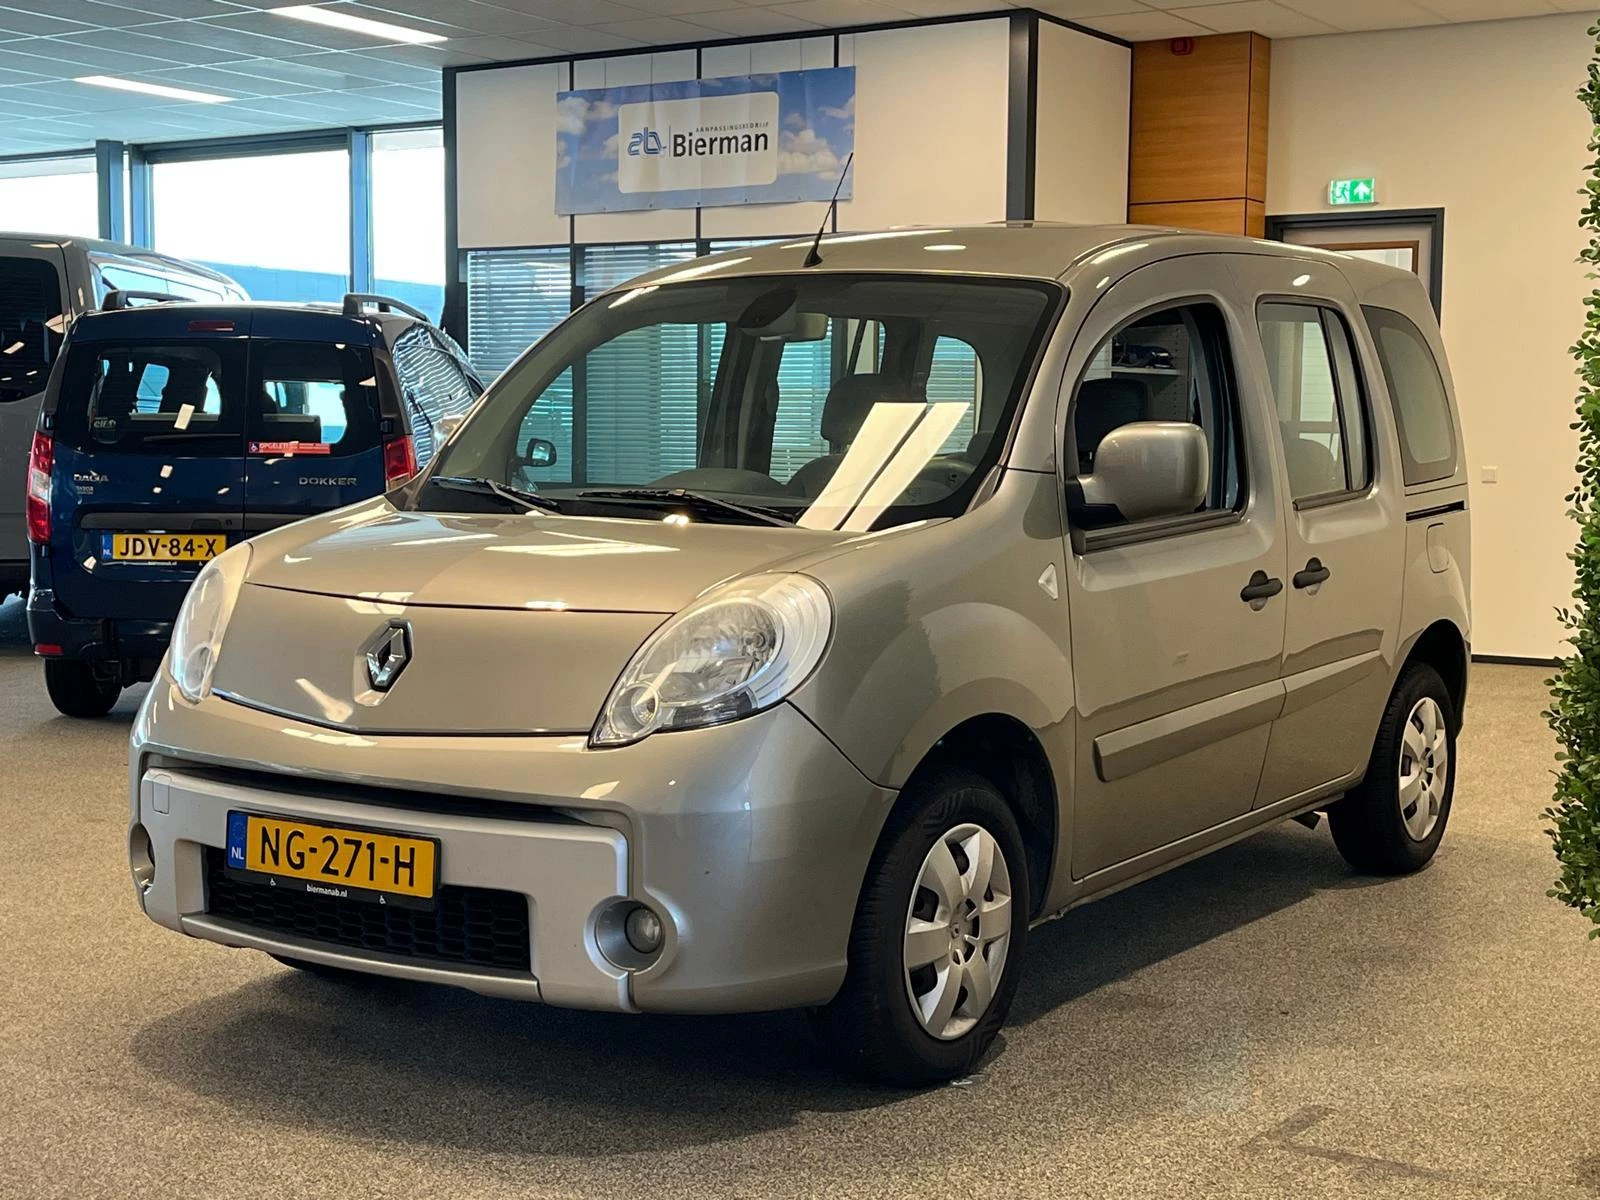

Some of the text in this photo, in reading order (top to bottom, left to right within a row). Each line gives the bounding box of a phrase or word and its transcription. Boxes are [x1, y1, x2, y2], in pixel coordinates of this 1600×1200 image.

[695, 122, 769, 133] AANPASSINGSBEDRIJF
[673, 131, 769, 158] Bierman
[299, 476, 357, 486] DOKKER
[120, 537, 217, 557] JDV-84-X
[231, 846, 245, 861] NL
[260, 825, 416, 888] NG-271-H
[306, 883, 348, 898] biermanab.nl
